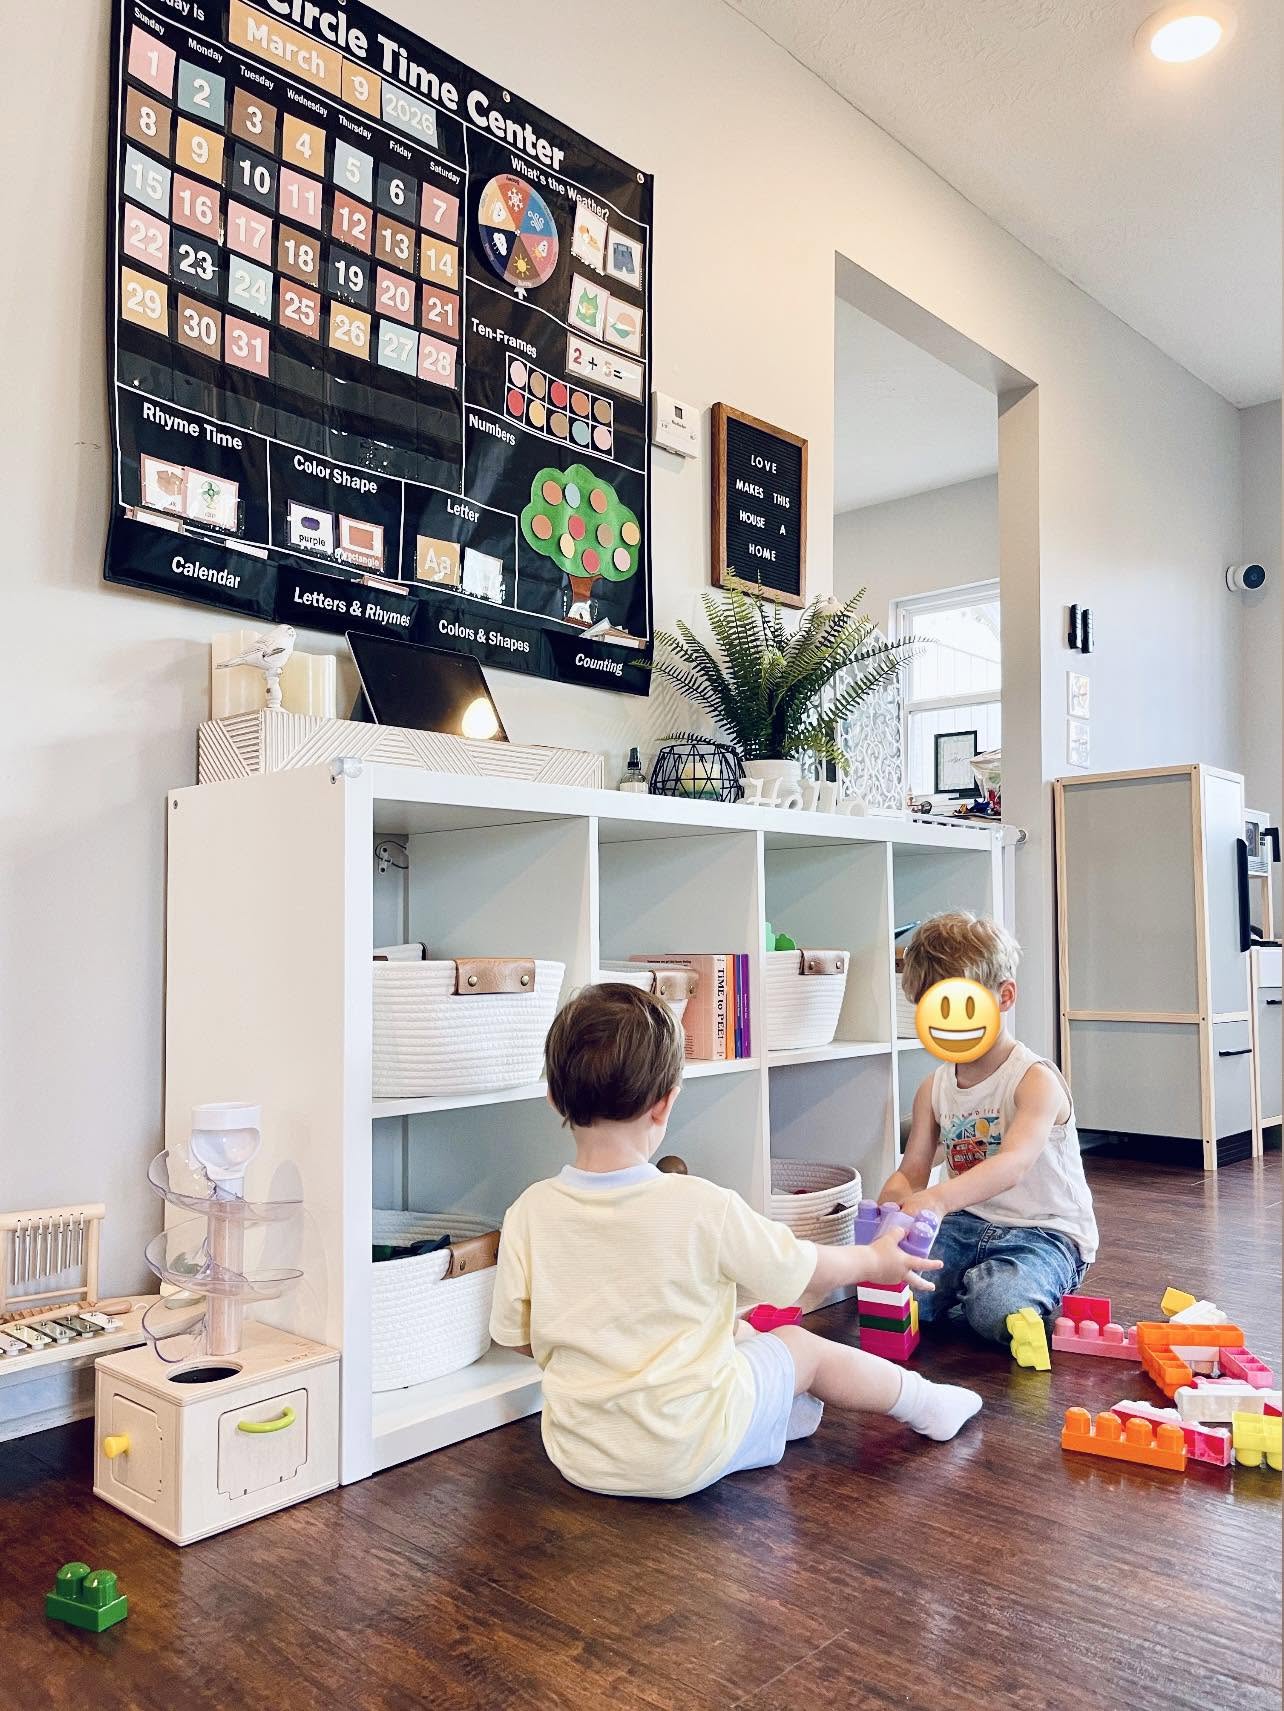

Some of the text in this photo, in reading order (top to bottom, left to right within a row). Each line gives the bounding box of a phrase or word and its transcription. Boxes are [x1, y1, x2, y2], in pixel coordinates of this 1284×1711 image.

[193, 3, 205, 21] is
[247, 17, 435, 135] March 9 2026
[134, 7, 460, 184] Sunday Monday Tuesday Wednesday Thursday Friday Saturday
[378, 33, 459, 110] Time
[467, 90, 565, 170] Center
[147, 48, 447, 224] 1 2 3 4 5 6 7
[139, 106, 157, 137] 8
[191, 136, 209, 164] 9
[240, 160, 271, 194] 10
[287, 183, 315, 216] 11
[339, 206, 366, 241] 12
[382, 228, 409, 260] 13
[427, 248, 453, 277] 14
[510, 154, 547, 187] What's
[547, 178, 566, 197] the
[566, 188, 609, 221] Weather?
[131, 158, 453, 326] 15 16 17 18 19 20 21
[130, 219, 450, 376] 22 23 24 25 26 27 28
[127, 281, 262, 363] 29 30 31
[471, 317, 537, 359] Ten-Frames
[573, 347, 582, 366] 2
[143, 402, 243, 450] Rhyme Time
[469, 414, 516, 446] Numbers
[293, 455, 378, 494] Color Shape
[750, 455, 777, 474] LOVE
[447, 499, 480, 523] Letter
[736, 479, 790, 509] MAKES THIS
[299, 534, 326, 547] purple
[739, 510, 786, 536] HOUSE A
[749, 543, 776, 561] HOME
[172, 556, 241, 588] Calendar
[294, 587, 411, 627] Letters & Rhymes
[438, 620, 530, 653] Colors & Shapes
[575, 653, 623, 676] Counting
[717, 999, 725, 1011] to
